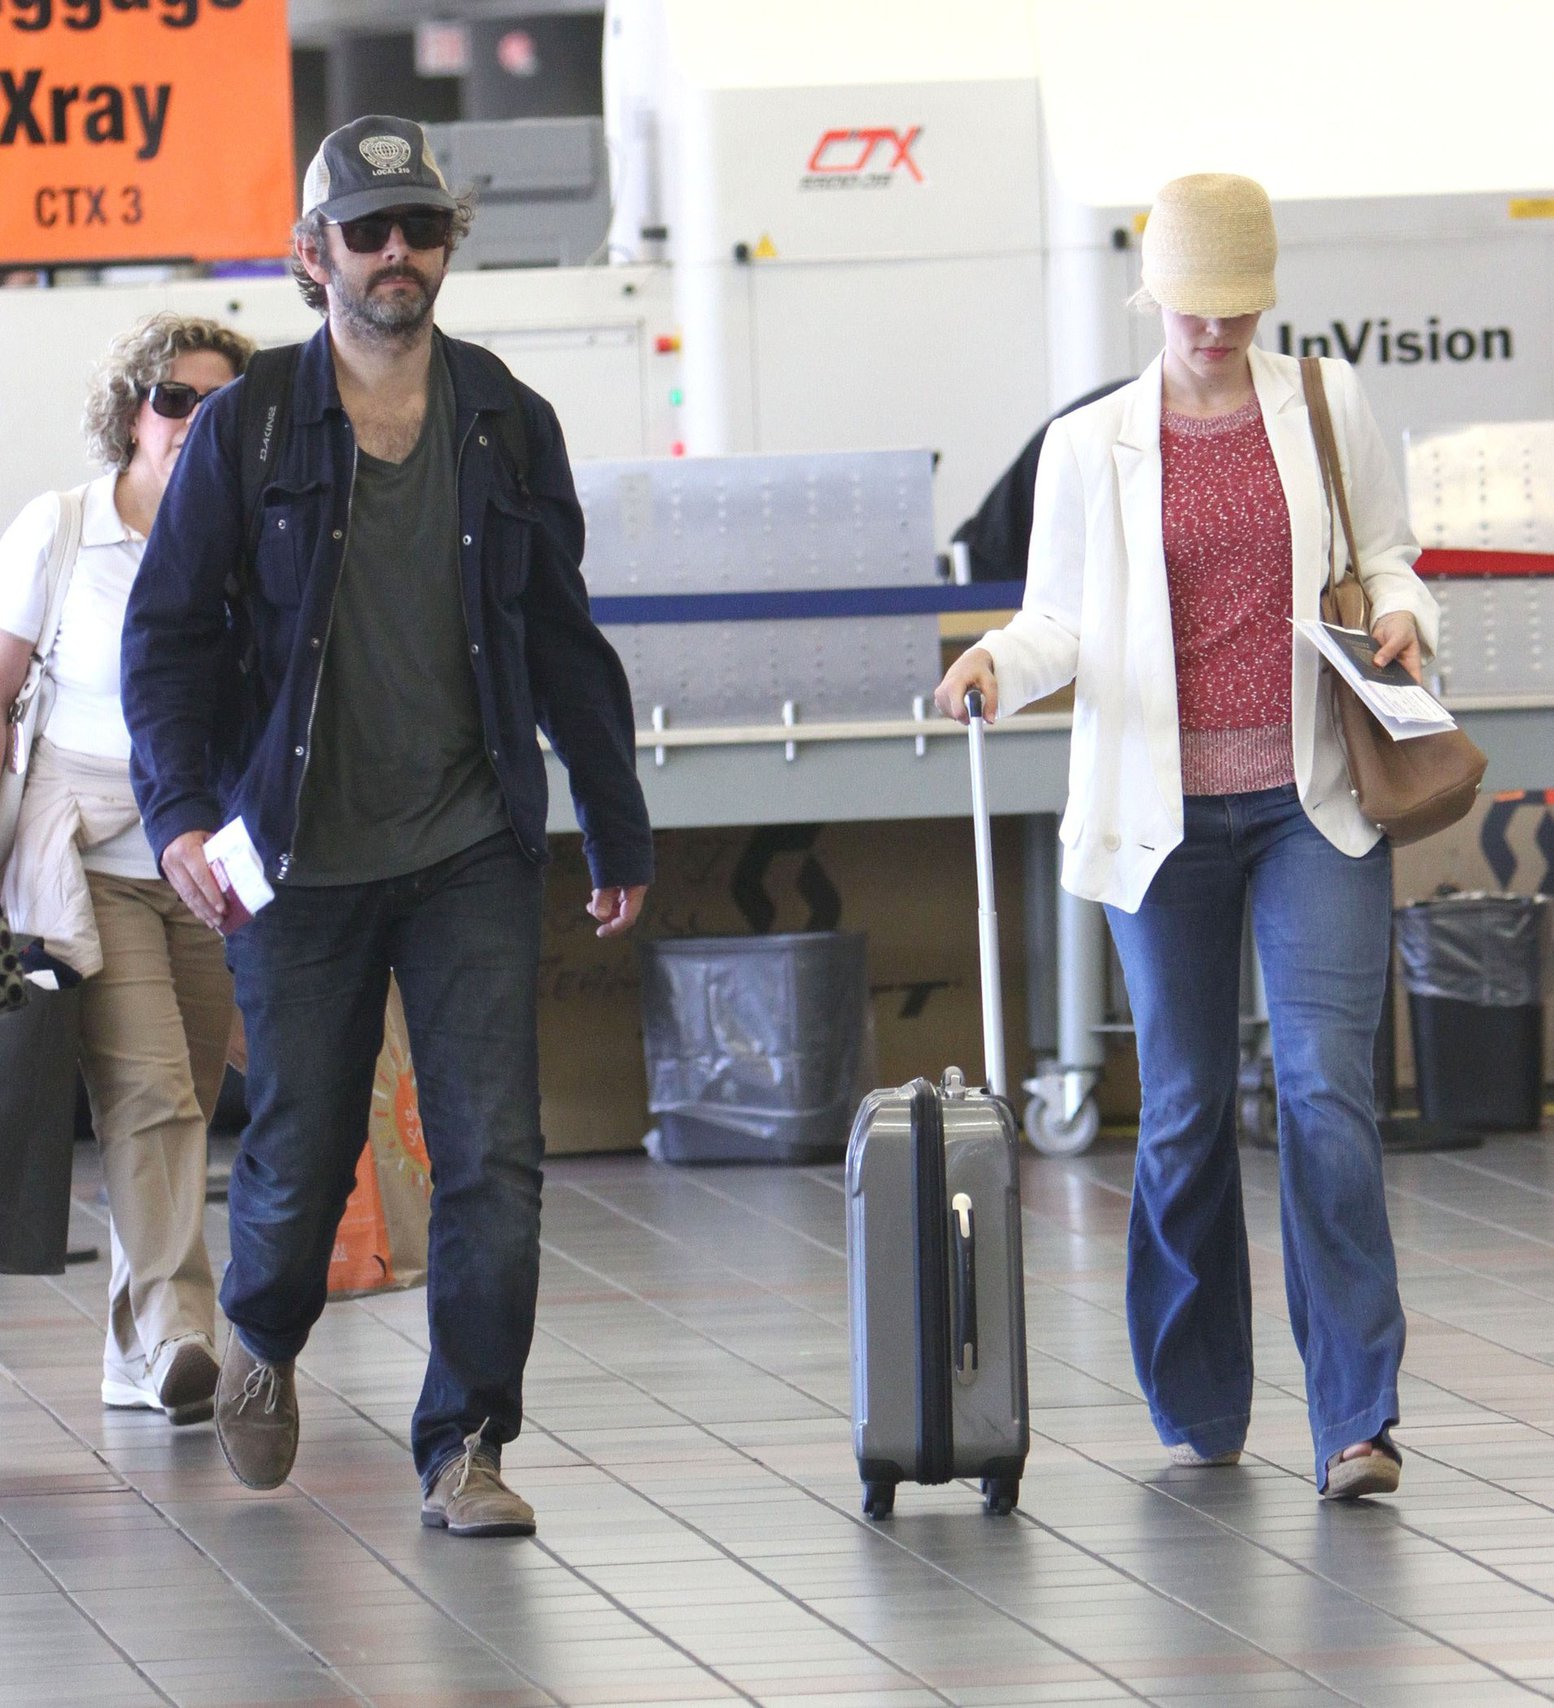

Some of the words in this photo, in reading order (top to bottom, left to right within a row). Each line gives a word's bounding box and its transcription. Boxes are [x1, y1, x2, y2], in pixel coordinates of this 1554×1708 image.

[0, 69, 171, 160] Xray
[807, 125, 923, 183] CTX
[35, 187, 106, 228] CTX
[121, 187, 142, 225] 3
[1279, 317, 1514, 365] InVision
